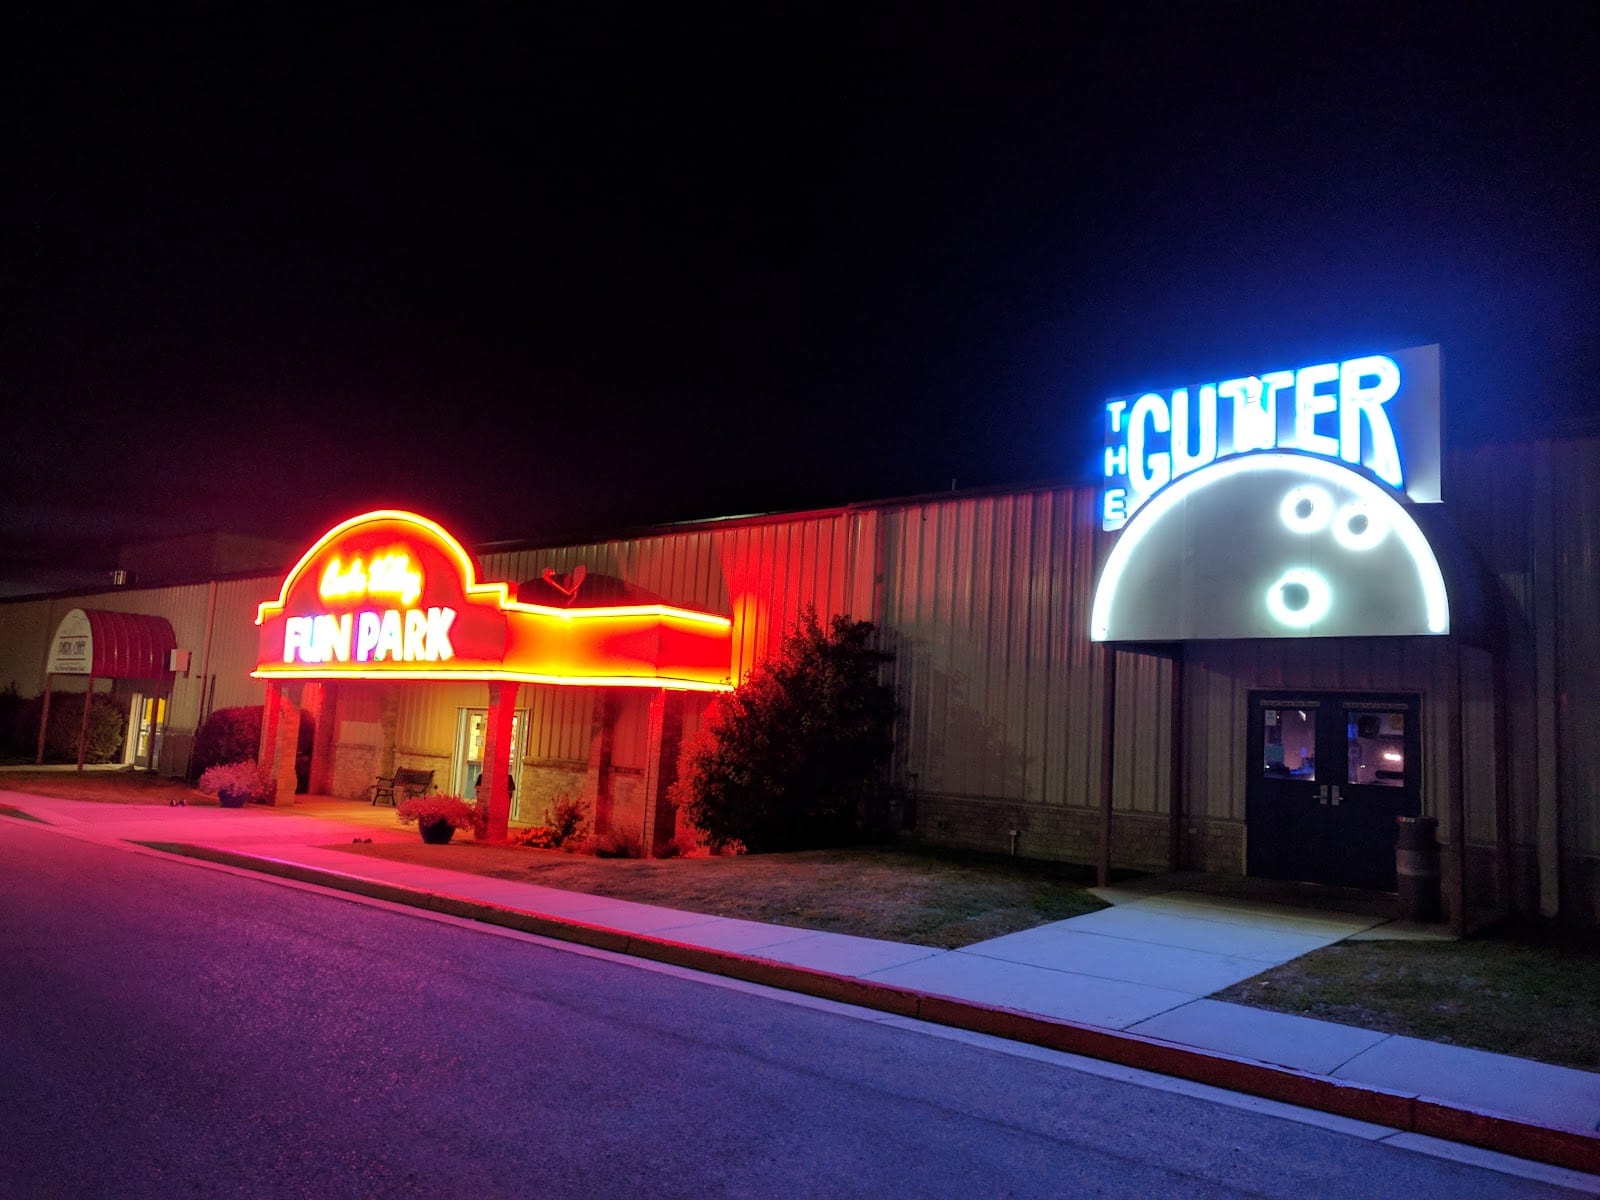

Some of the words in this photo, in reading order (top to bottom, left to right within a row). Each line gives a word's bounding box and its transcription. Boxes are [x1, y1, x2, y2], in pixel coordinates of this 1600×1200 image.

[1105, 401, 1126, 520] THE
[1128, 355, 1403, 498] GUTTER
[284, 613, 352, 663] FUN
[357, 607, 456, 662] PARK
